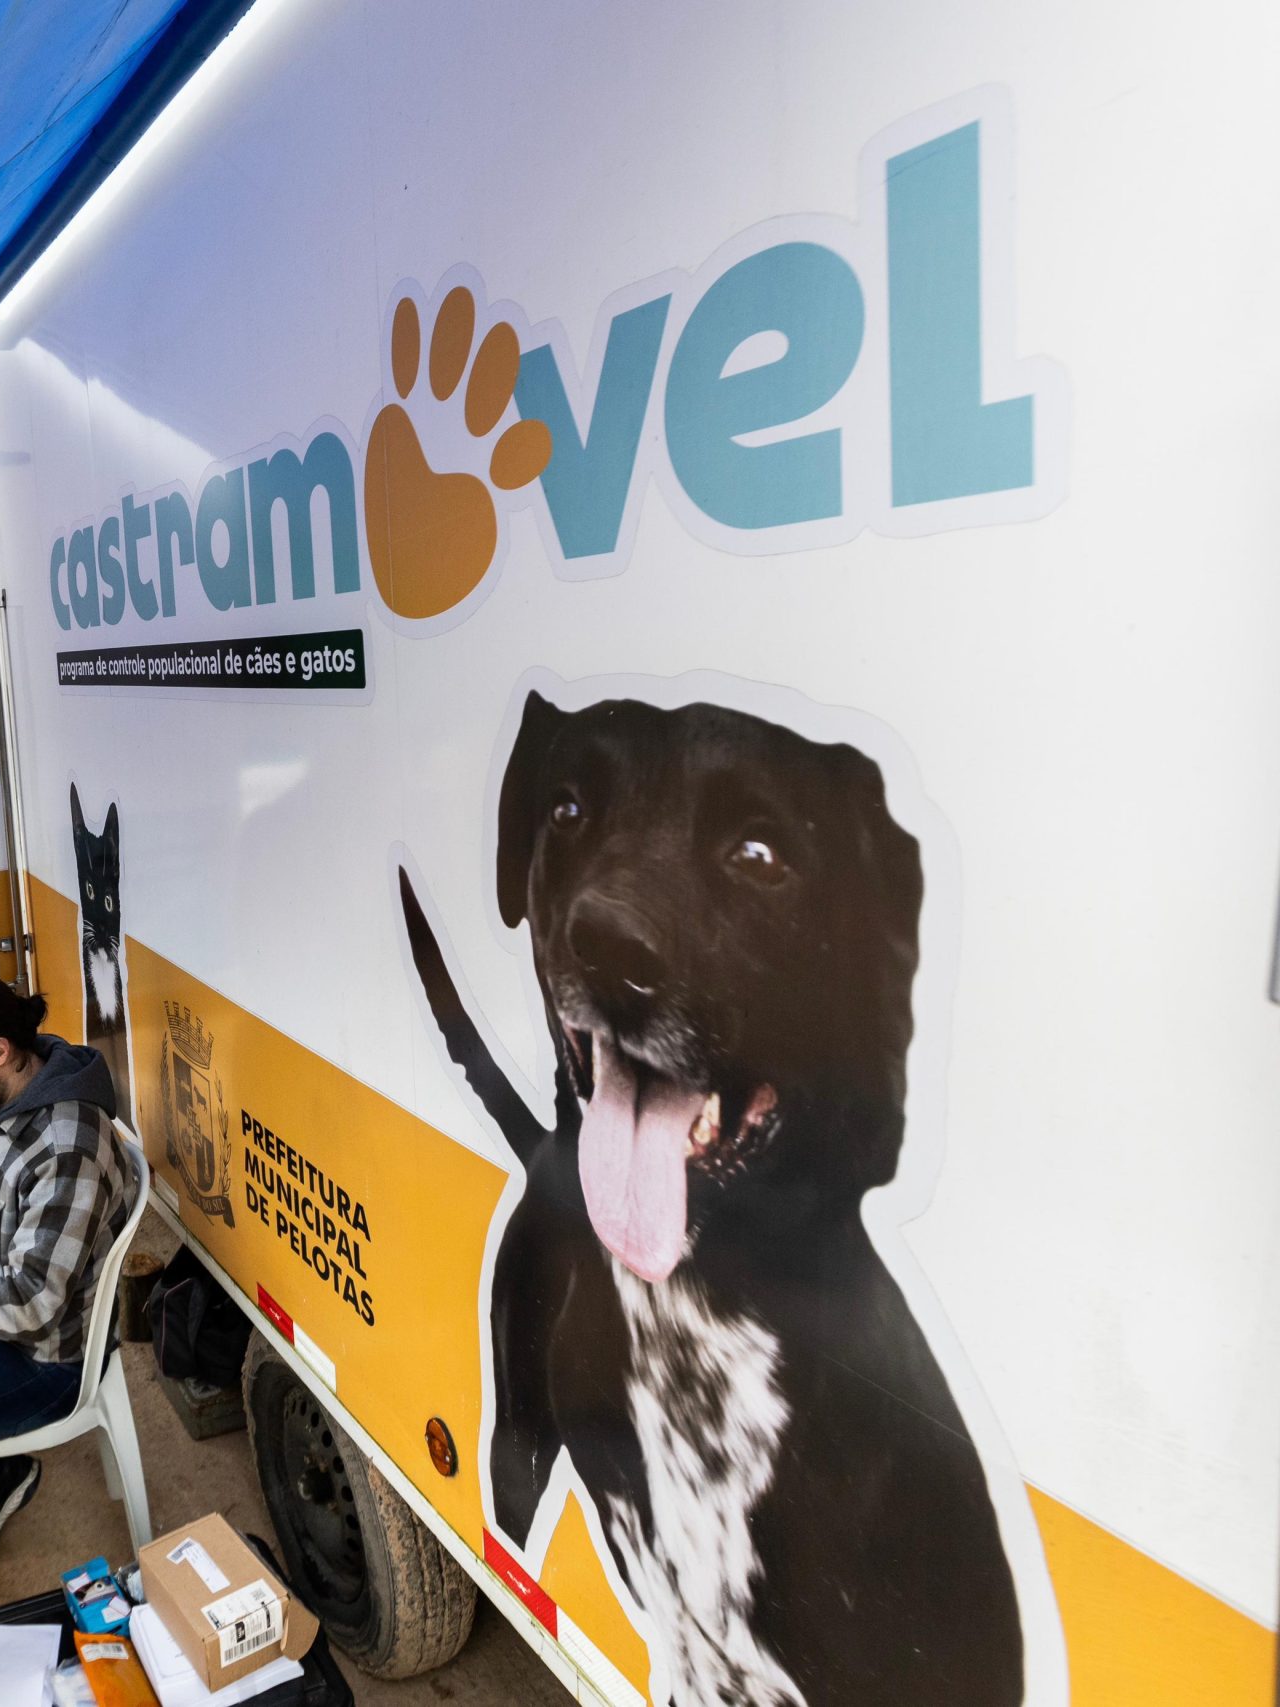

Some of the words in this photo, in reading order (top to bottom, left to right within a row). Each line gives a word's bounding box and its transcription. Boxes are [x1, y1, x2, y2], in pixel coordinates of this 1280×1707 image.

[59, 659, 95, 680] programa
[96, 655, 107, 675] de
[109, 653, 146, 676] controle
[148, 648, 221, 680] populacional
[224, 648, 243, 675] de
[246, 646, 282, 675] cães
[285, 651, 296, 674] e
[300, 645, 356, 681] gatos
[241, 1108, 372, 1243] PREFEITURA
[245, 1147, 368, 1281] MUNICIPAL
[245, 1181, 270, 1227] DE
[276, 1209, 375, 1327] PELOTAS
